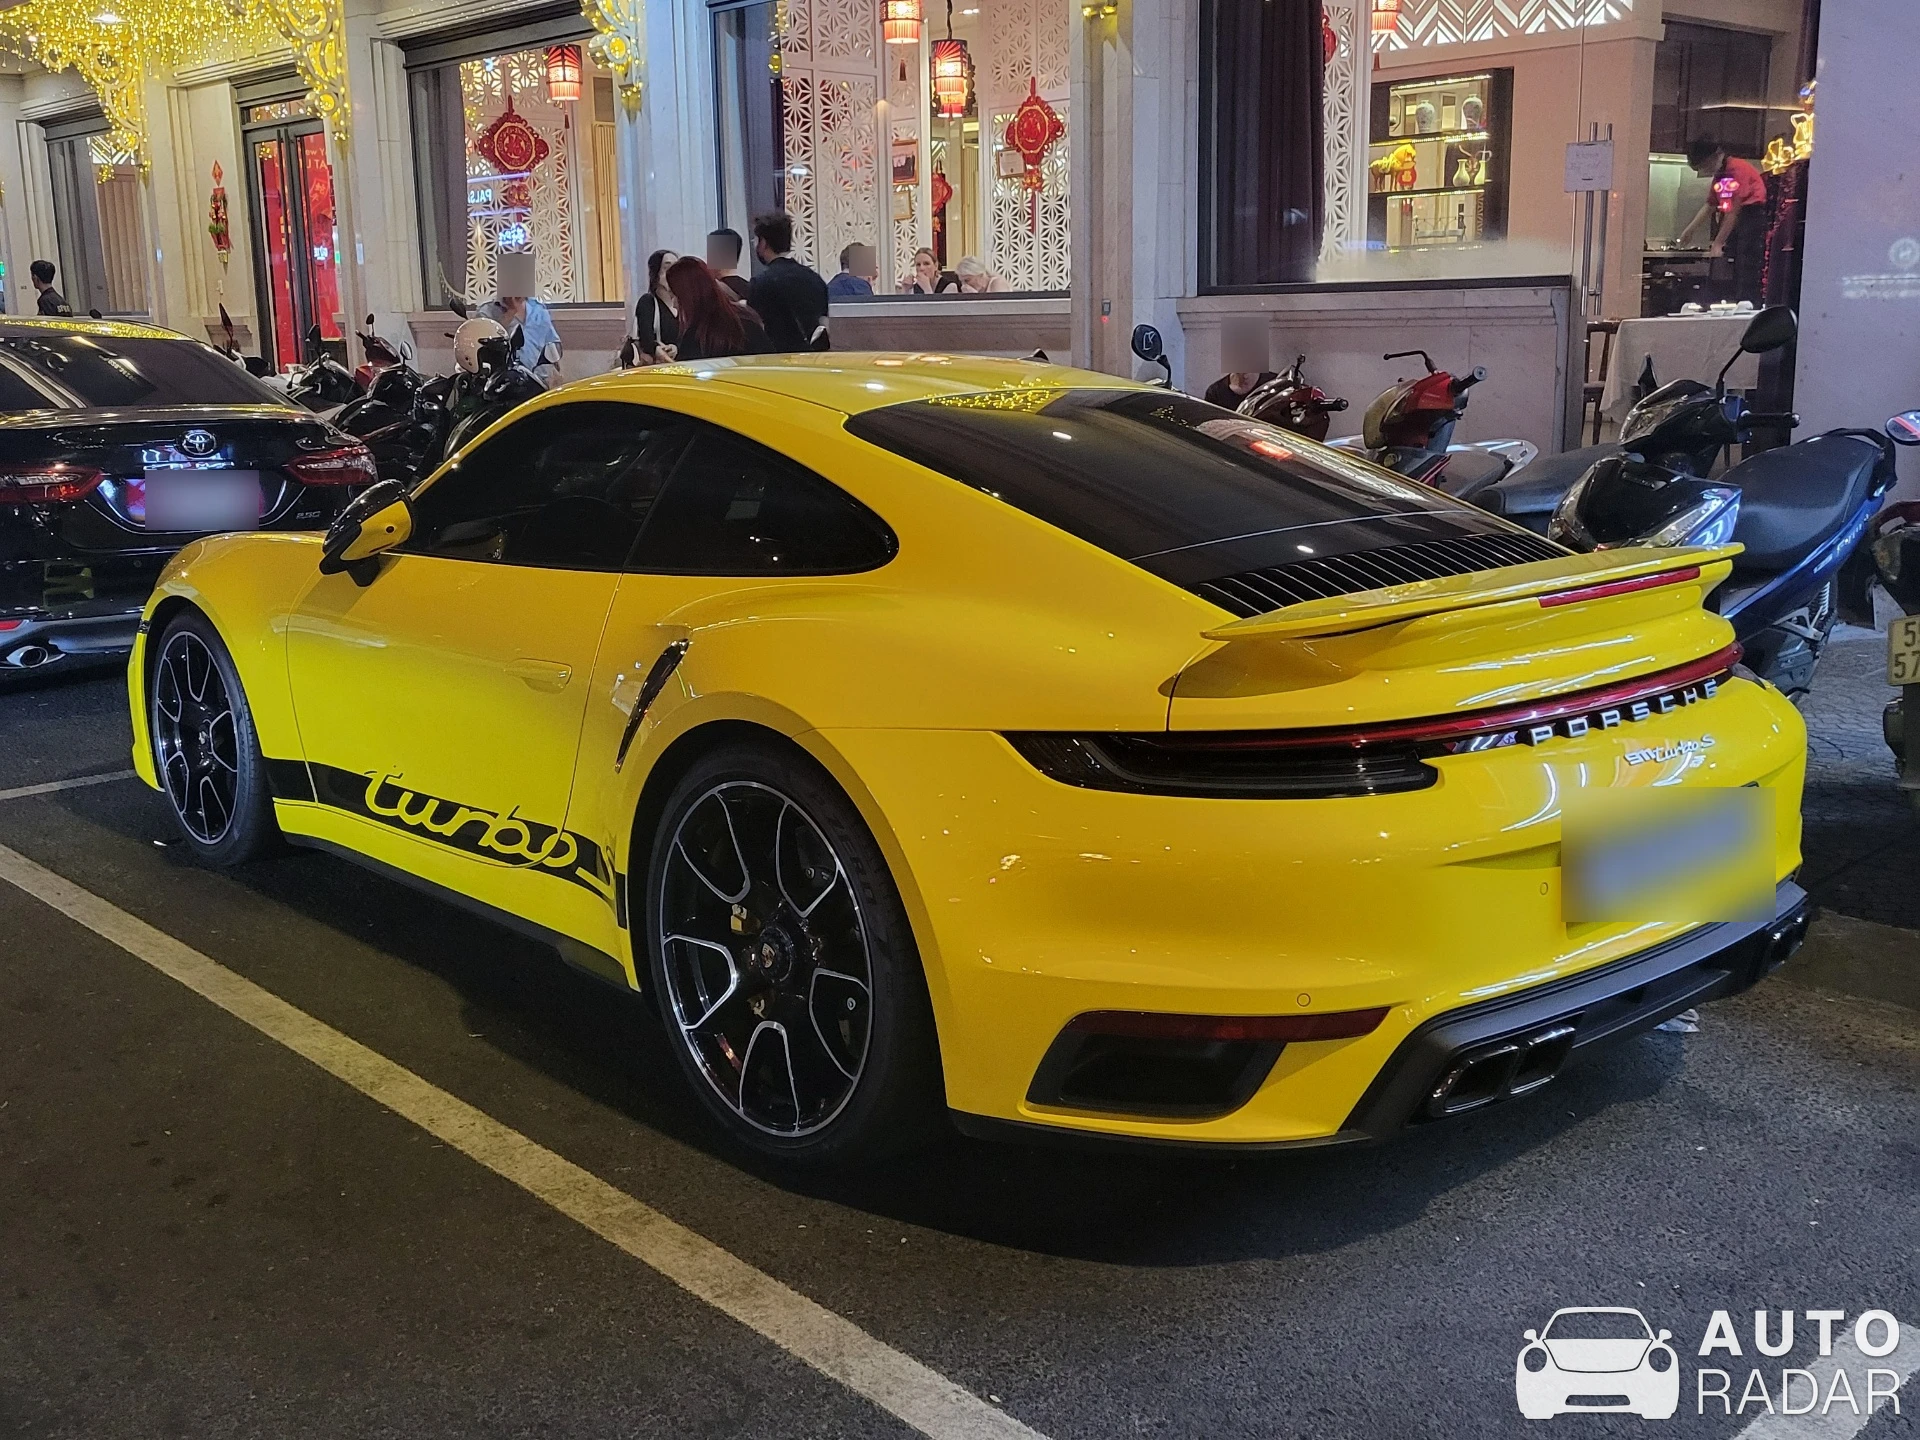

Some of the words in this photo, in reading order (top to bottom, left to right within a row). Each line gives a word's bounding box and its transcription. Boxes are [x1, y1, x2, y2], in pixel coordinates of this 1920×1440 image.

[1904, 620, 1920, 648] 5
[1530, 679, 1718, 746] PORSCHE
[364, 770, 578, 868] turbo
